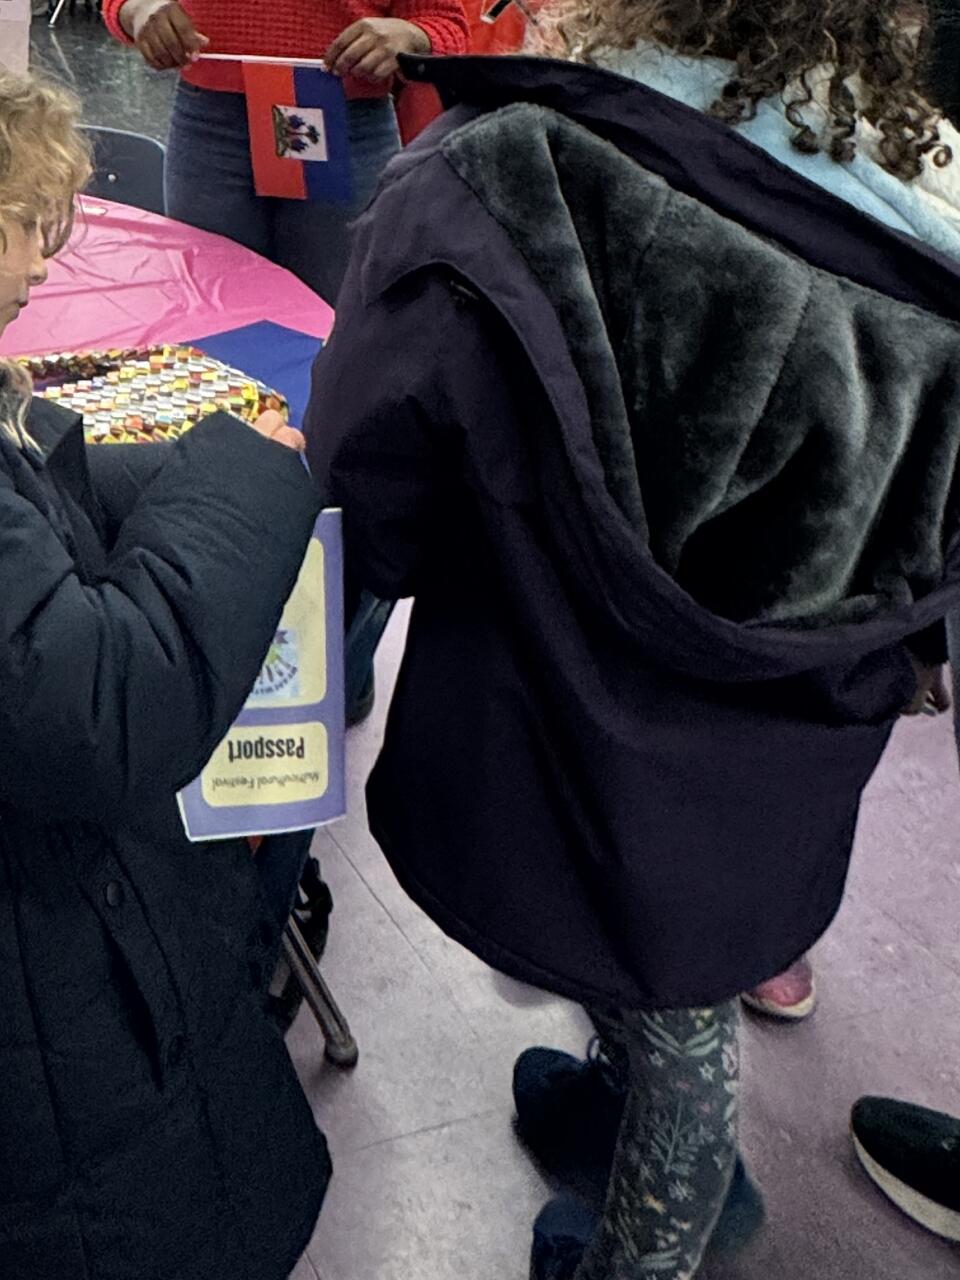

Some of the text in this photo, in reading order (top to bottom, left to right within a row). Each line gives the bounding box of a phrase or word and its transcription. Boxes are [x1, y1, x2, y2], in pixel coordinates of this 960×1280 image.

[226, 736, 306, 763] Passport
[211, 771, 320, 792] Multicultural Festival
